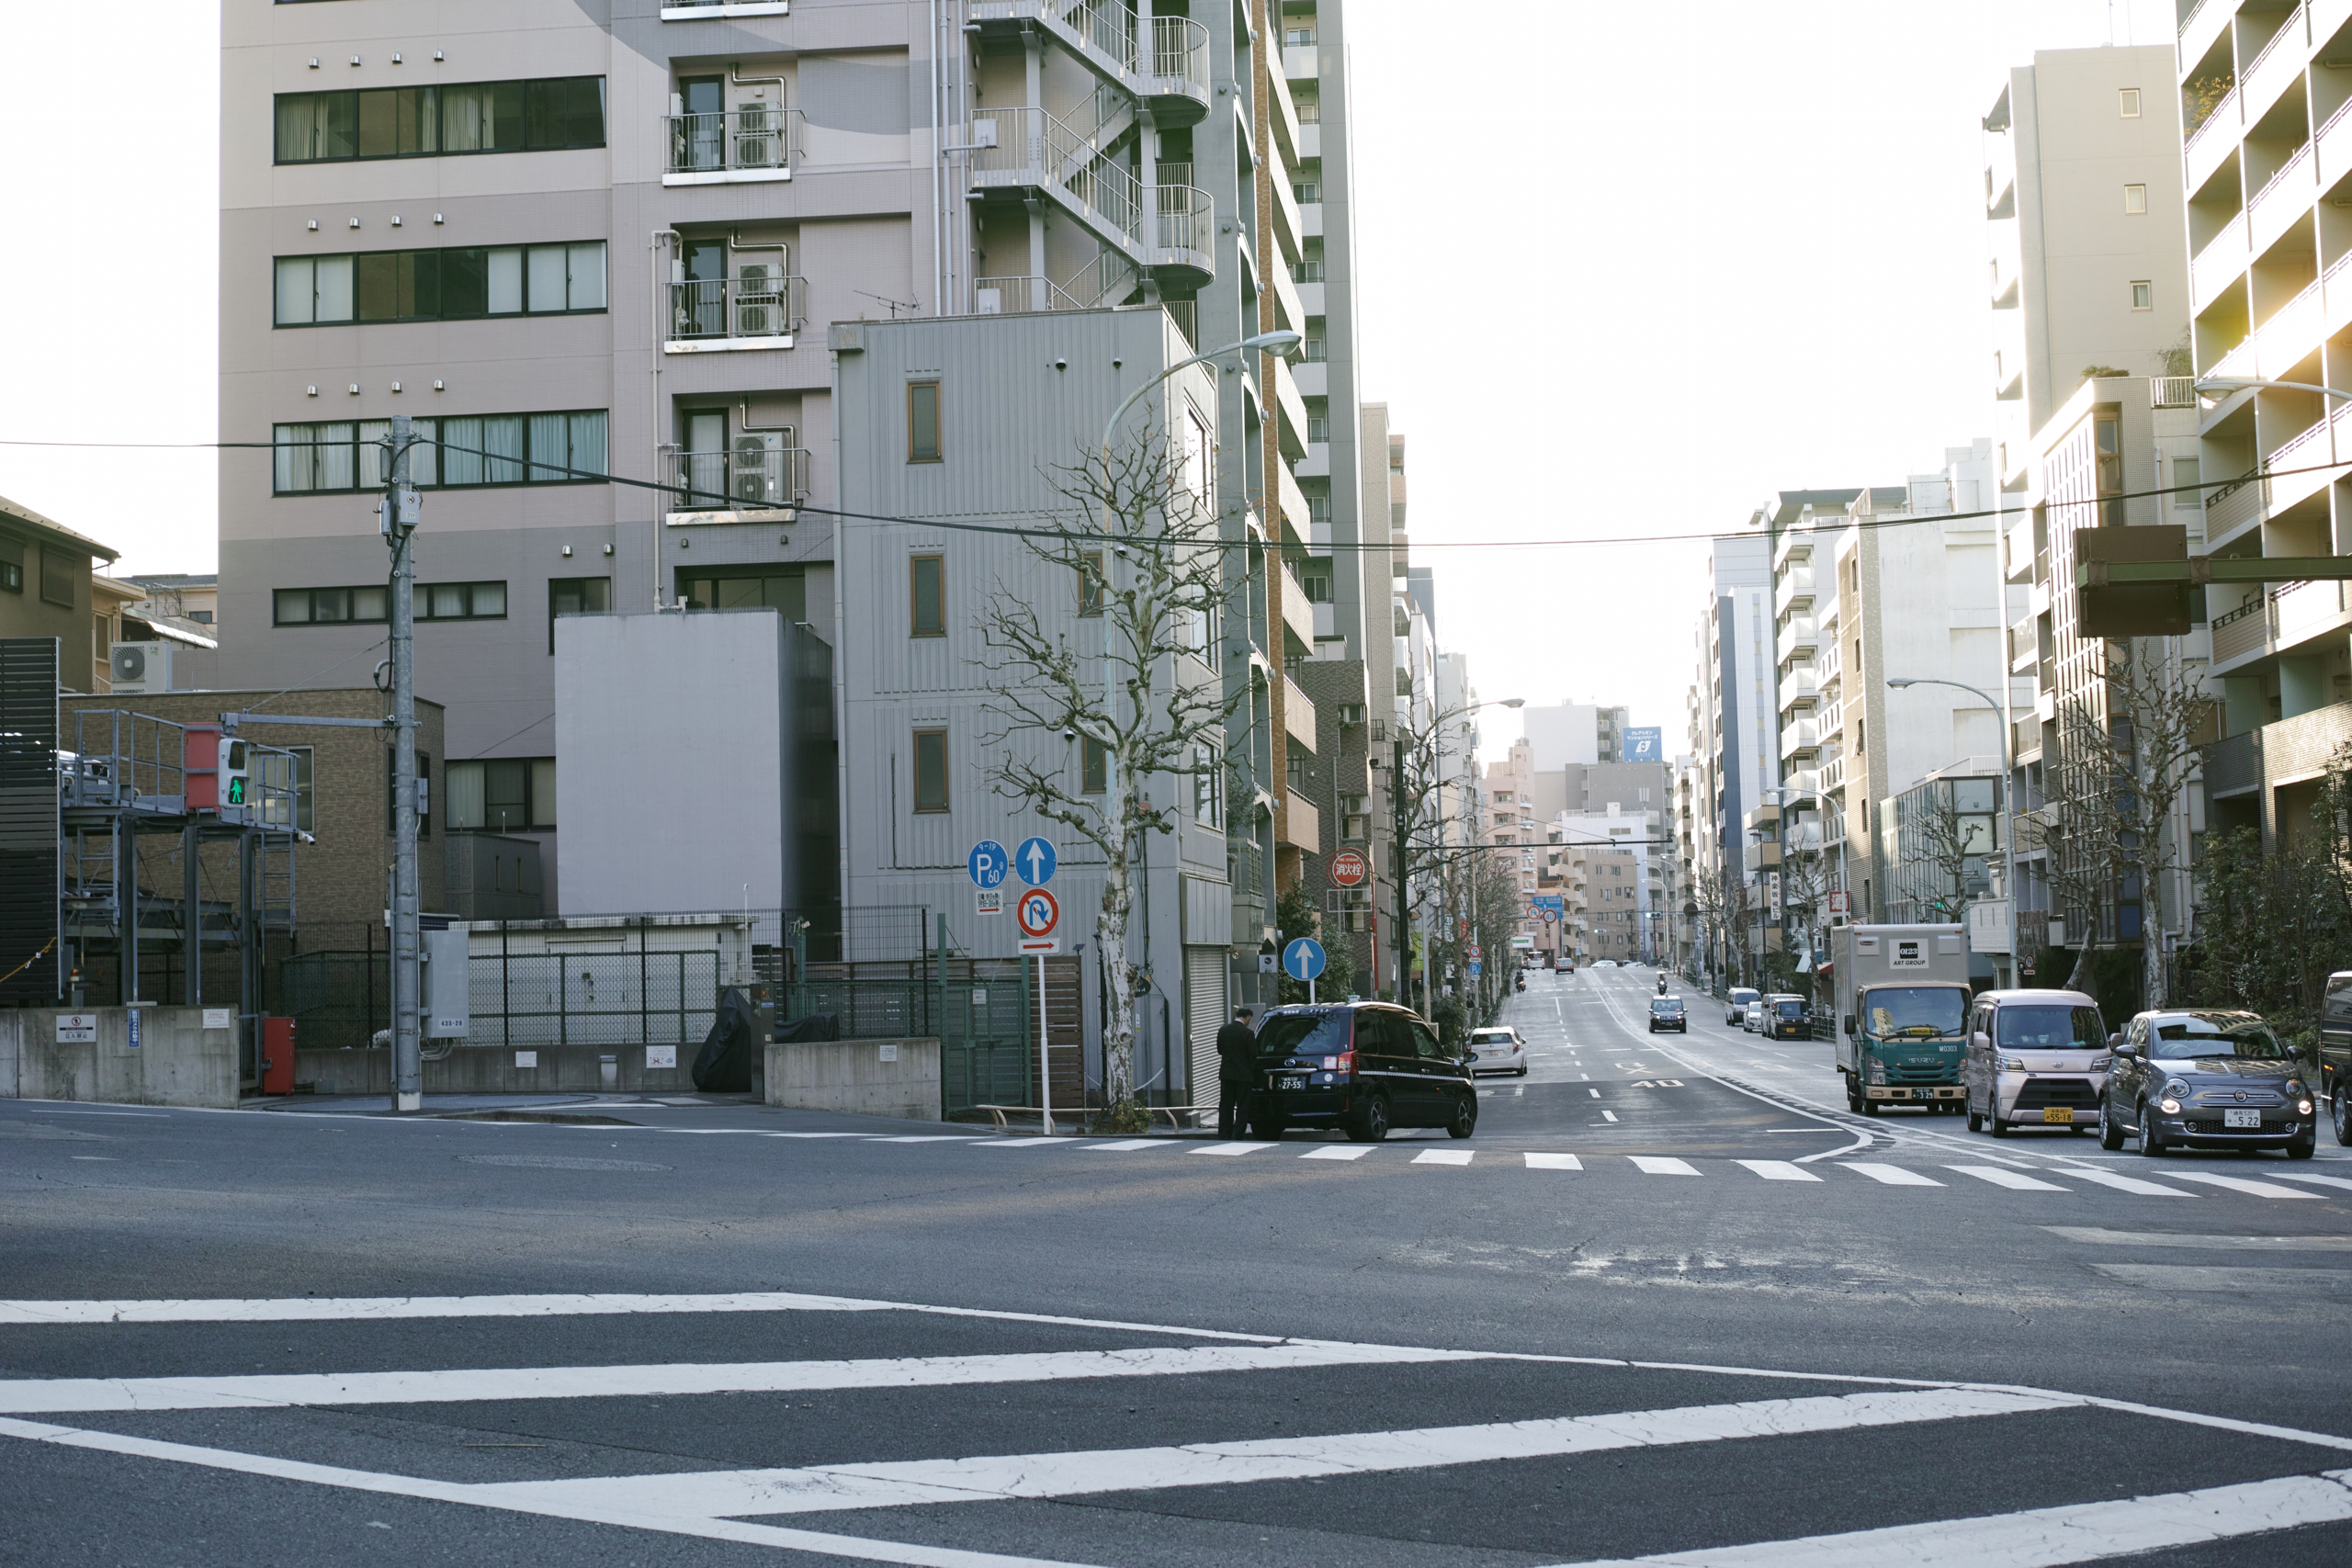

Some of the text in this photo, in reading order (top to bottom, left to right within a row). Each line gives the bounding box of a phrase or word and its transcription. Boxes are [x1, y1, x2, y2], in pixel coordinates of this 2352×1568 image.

[978, 842, 996, 851] 9-19
[977, 854, 992, 885] P
[1336, 863, 1362, 875] 消火栓
[988, 870, 1000, 884] 60
[1283, 1081, 1301, 1089] 27-55
[1631, 1079, 1685, 1088] 40
[2051, 1113, 2072, 1122] 55-18
